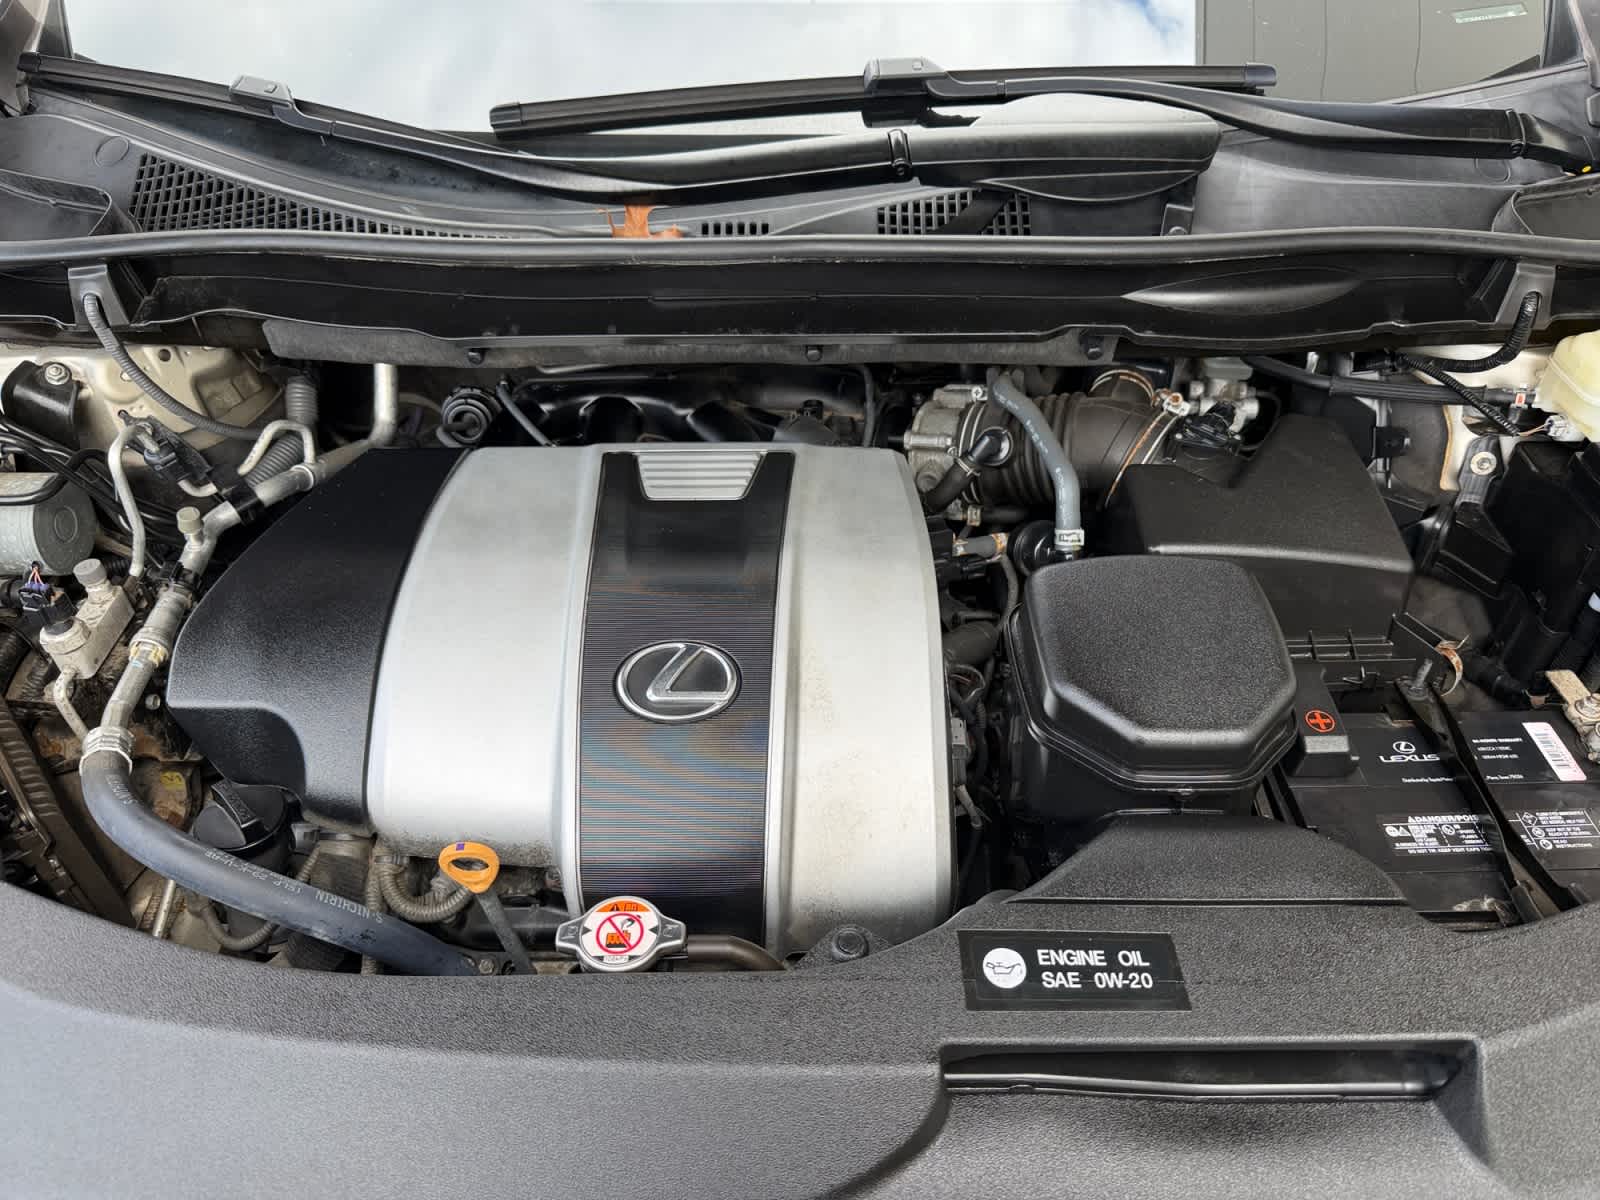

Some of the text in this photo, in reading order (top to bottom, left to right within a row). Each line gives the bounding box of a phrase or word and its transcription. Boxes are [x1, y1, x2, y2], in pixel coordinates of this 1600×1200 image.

[1379, 753, 1440, 763] LEXUS
[1036, 949, 1150, 966] ENGINE OIL
[1041, 971, 1153, 989] SAE 0W-20
